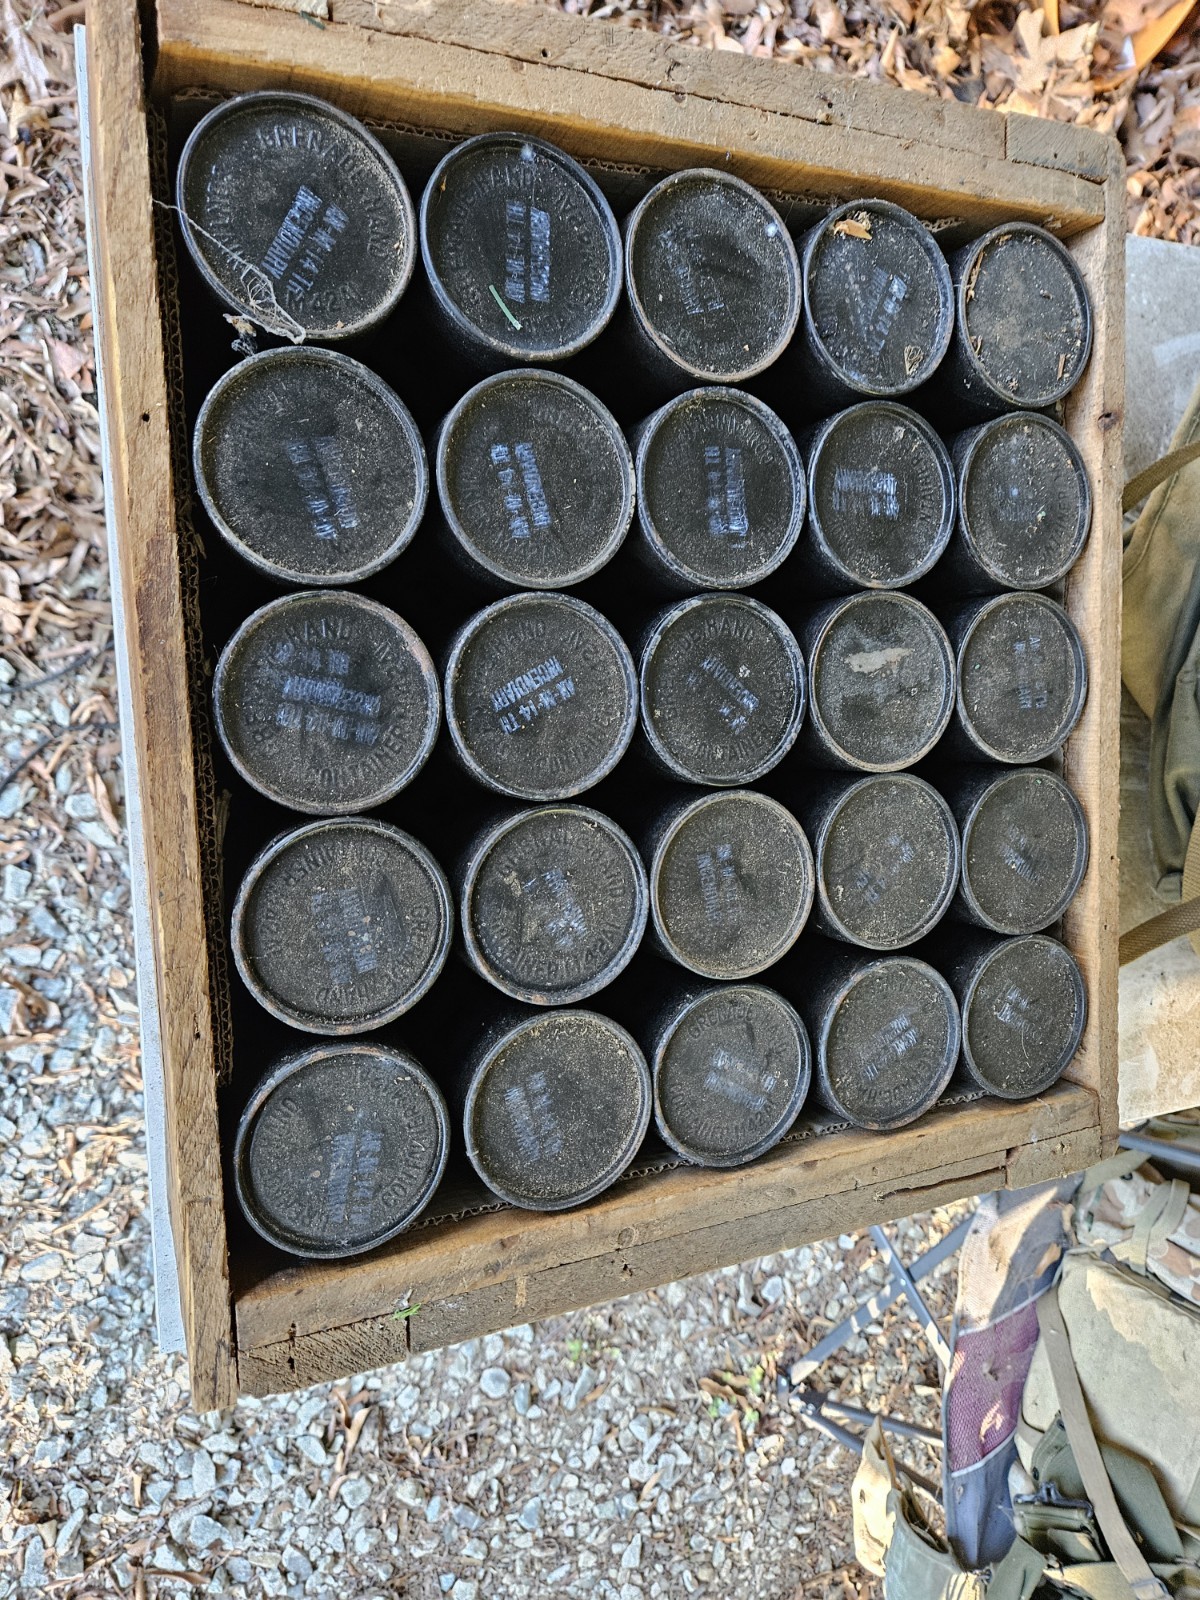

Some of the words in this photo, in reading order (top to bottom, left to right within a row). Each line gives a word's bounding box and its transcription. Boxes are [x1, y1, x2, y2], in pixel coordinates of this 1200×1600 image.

[256, 186, 323, 280] INCENDIARY
[486, 655, 565, 712] INCENDIARY
[497, 710, 521, 735] TH
